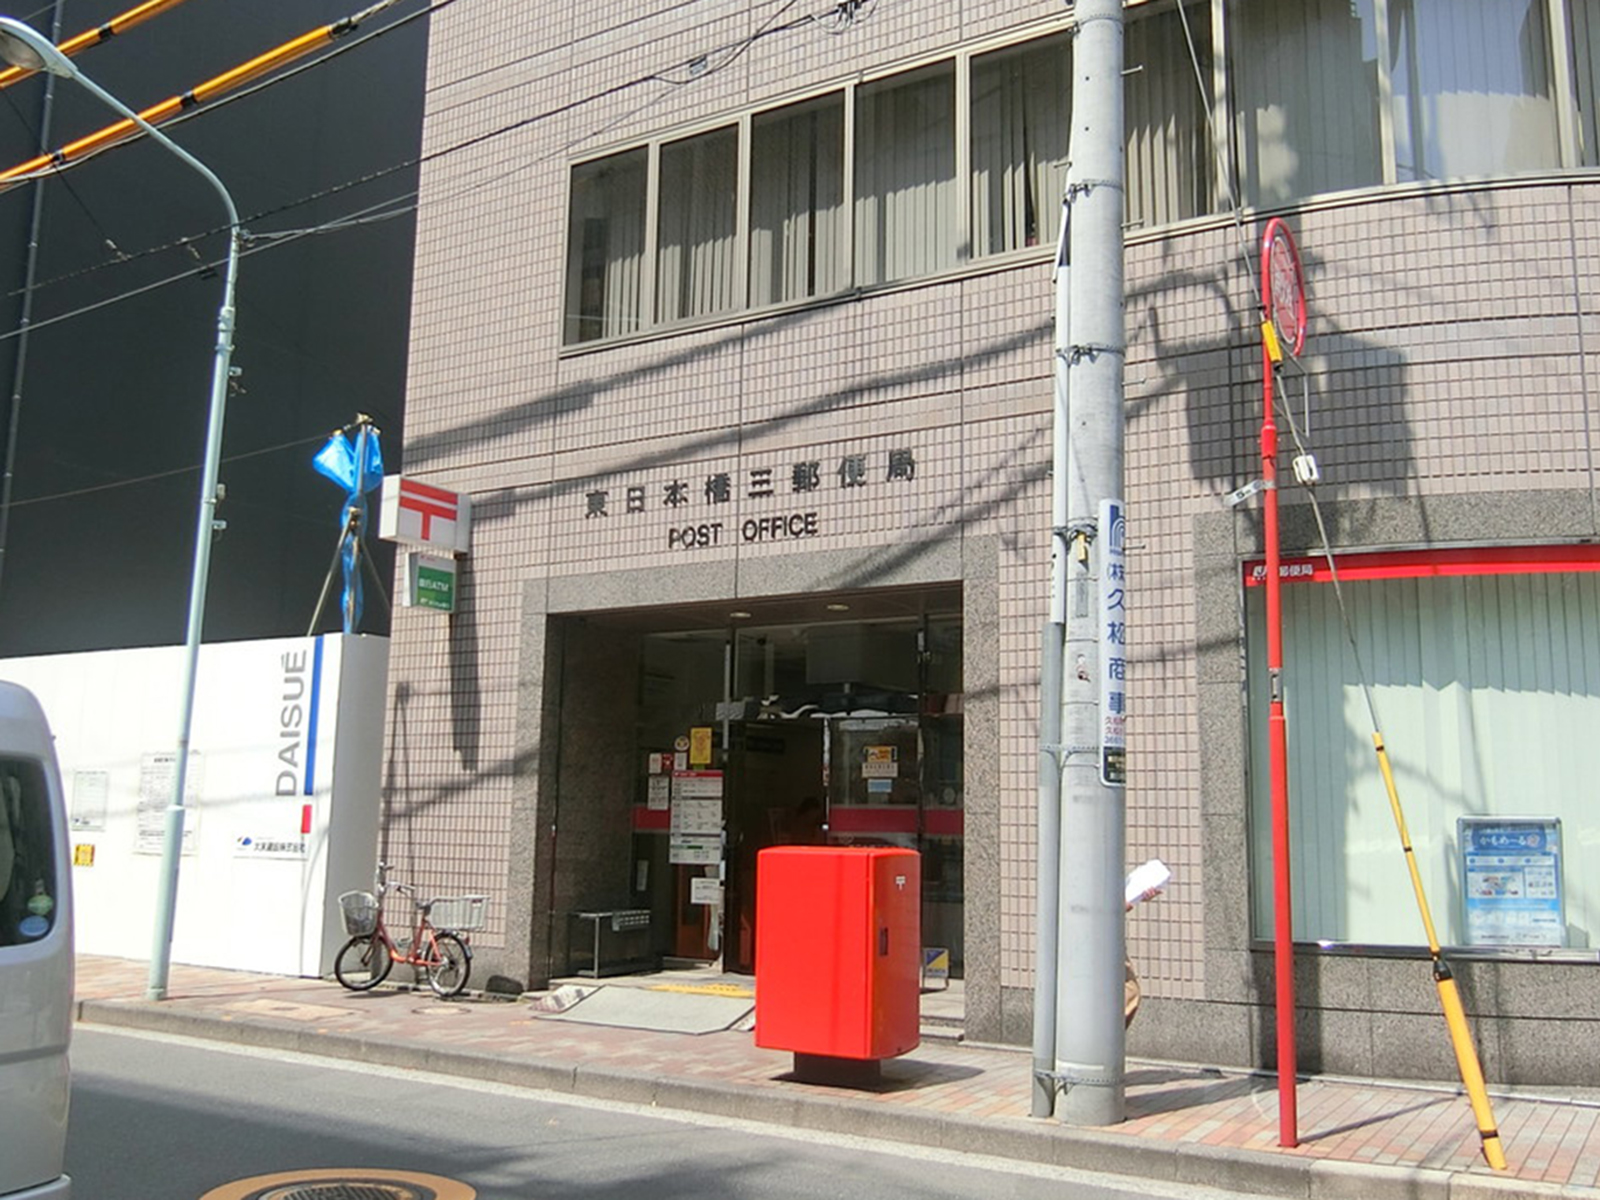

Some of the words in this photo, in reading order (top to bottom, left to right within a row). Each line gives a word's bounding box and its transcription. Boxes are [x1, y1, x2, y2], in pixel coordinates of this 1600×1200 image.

[584, 447, 916, 520] 東日本橋三郵便局
[668, 523, 723, 550] POST
[741, 511, 819, 542] OFFICE
